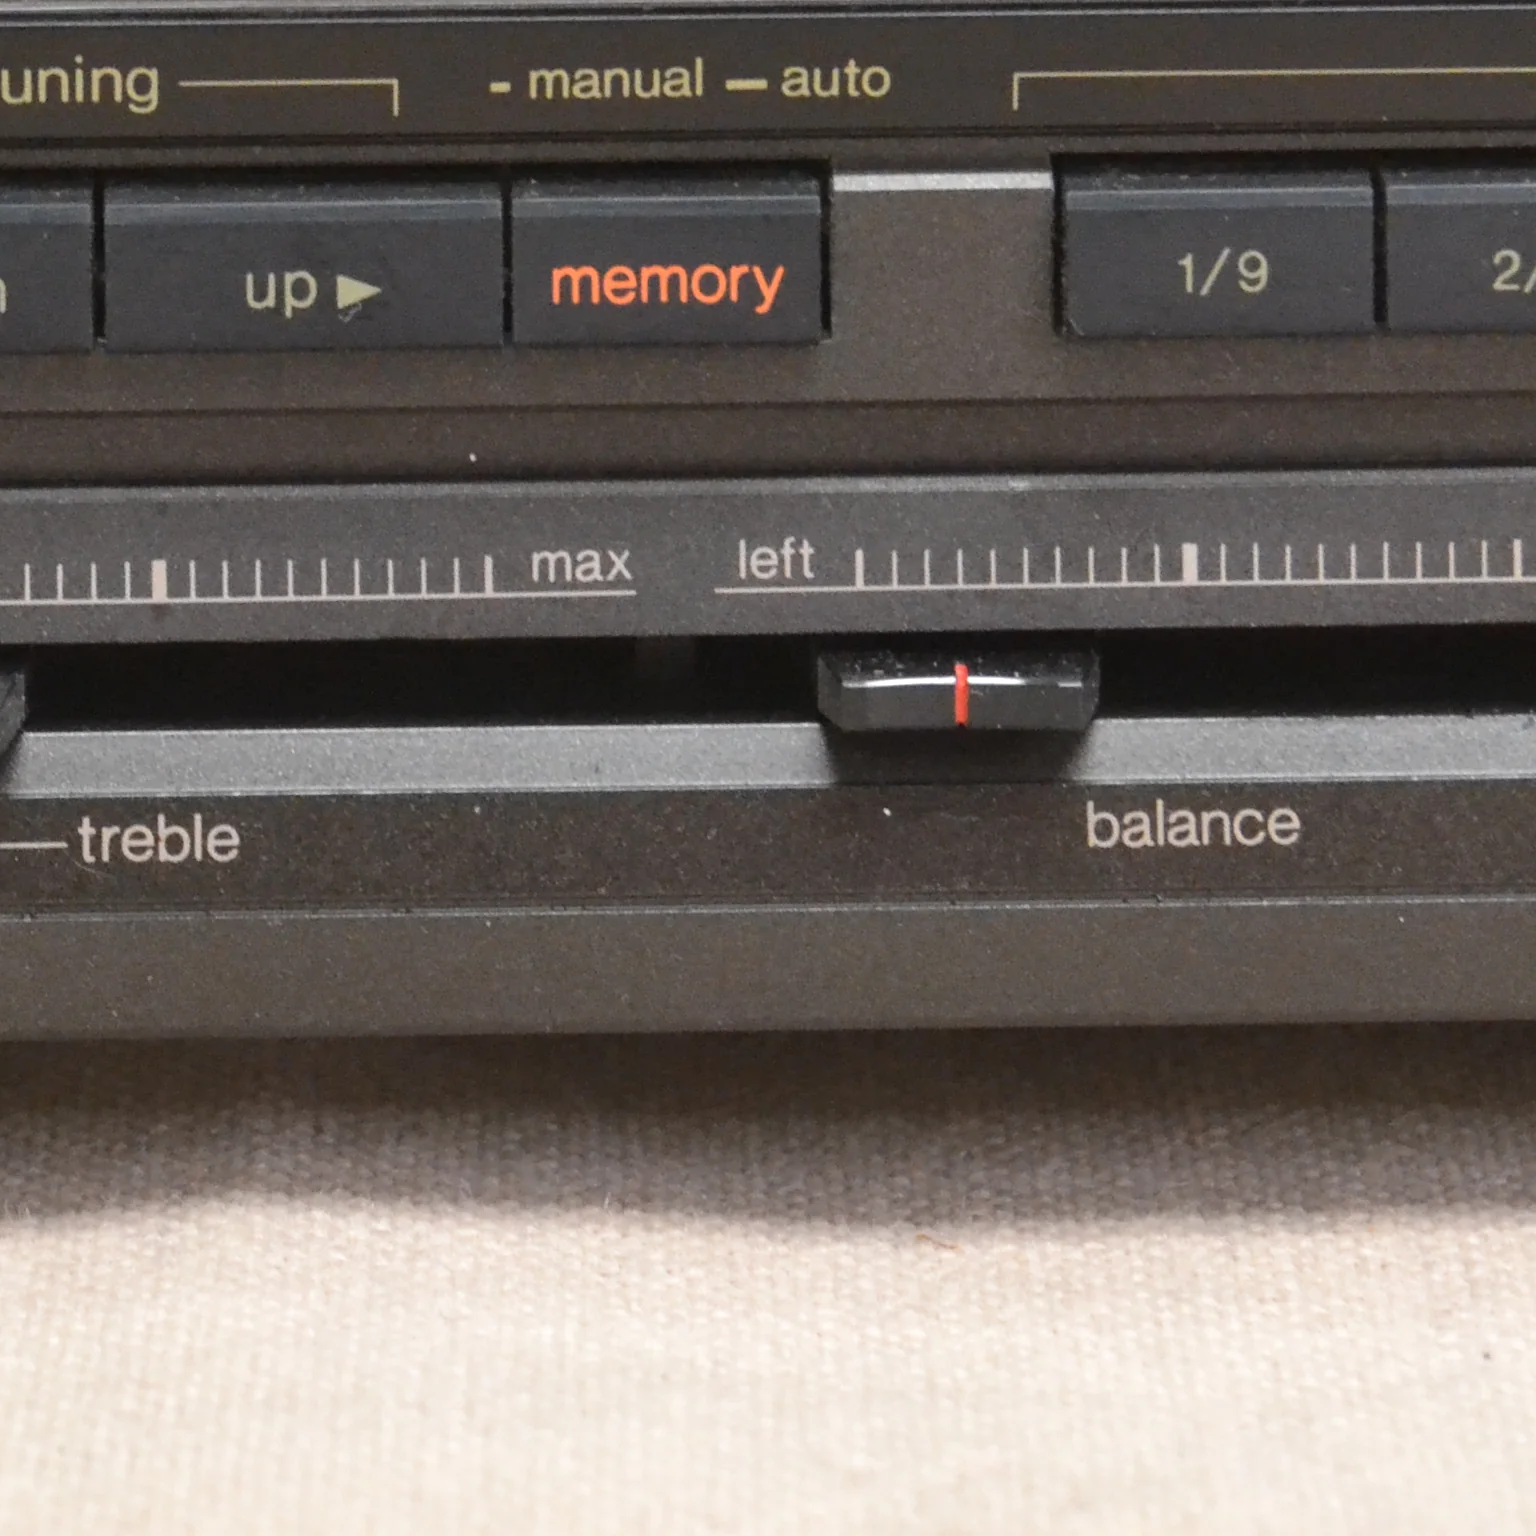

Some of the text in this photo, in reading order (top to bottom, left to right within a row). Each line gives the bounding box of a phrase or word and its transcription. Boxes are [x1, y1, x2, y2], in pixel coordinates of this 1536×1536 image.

[529, 56, 891, 100] manual auto
[245, 270, 318, 319] up
[551, 264, 785, 315] memory
[1178, 247, 1269, 296] 1/9
[531, 549, 632, 583] max
[738, 536, 815, 580] left
[77, 813, 240, 864] treble
[1086, 798, 1301, 849] balance
